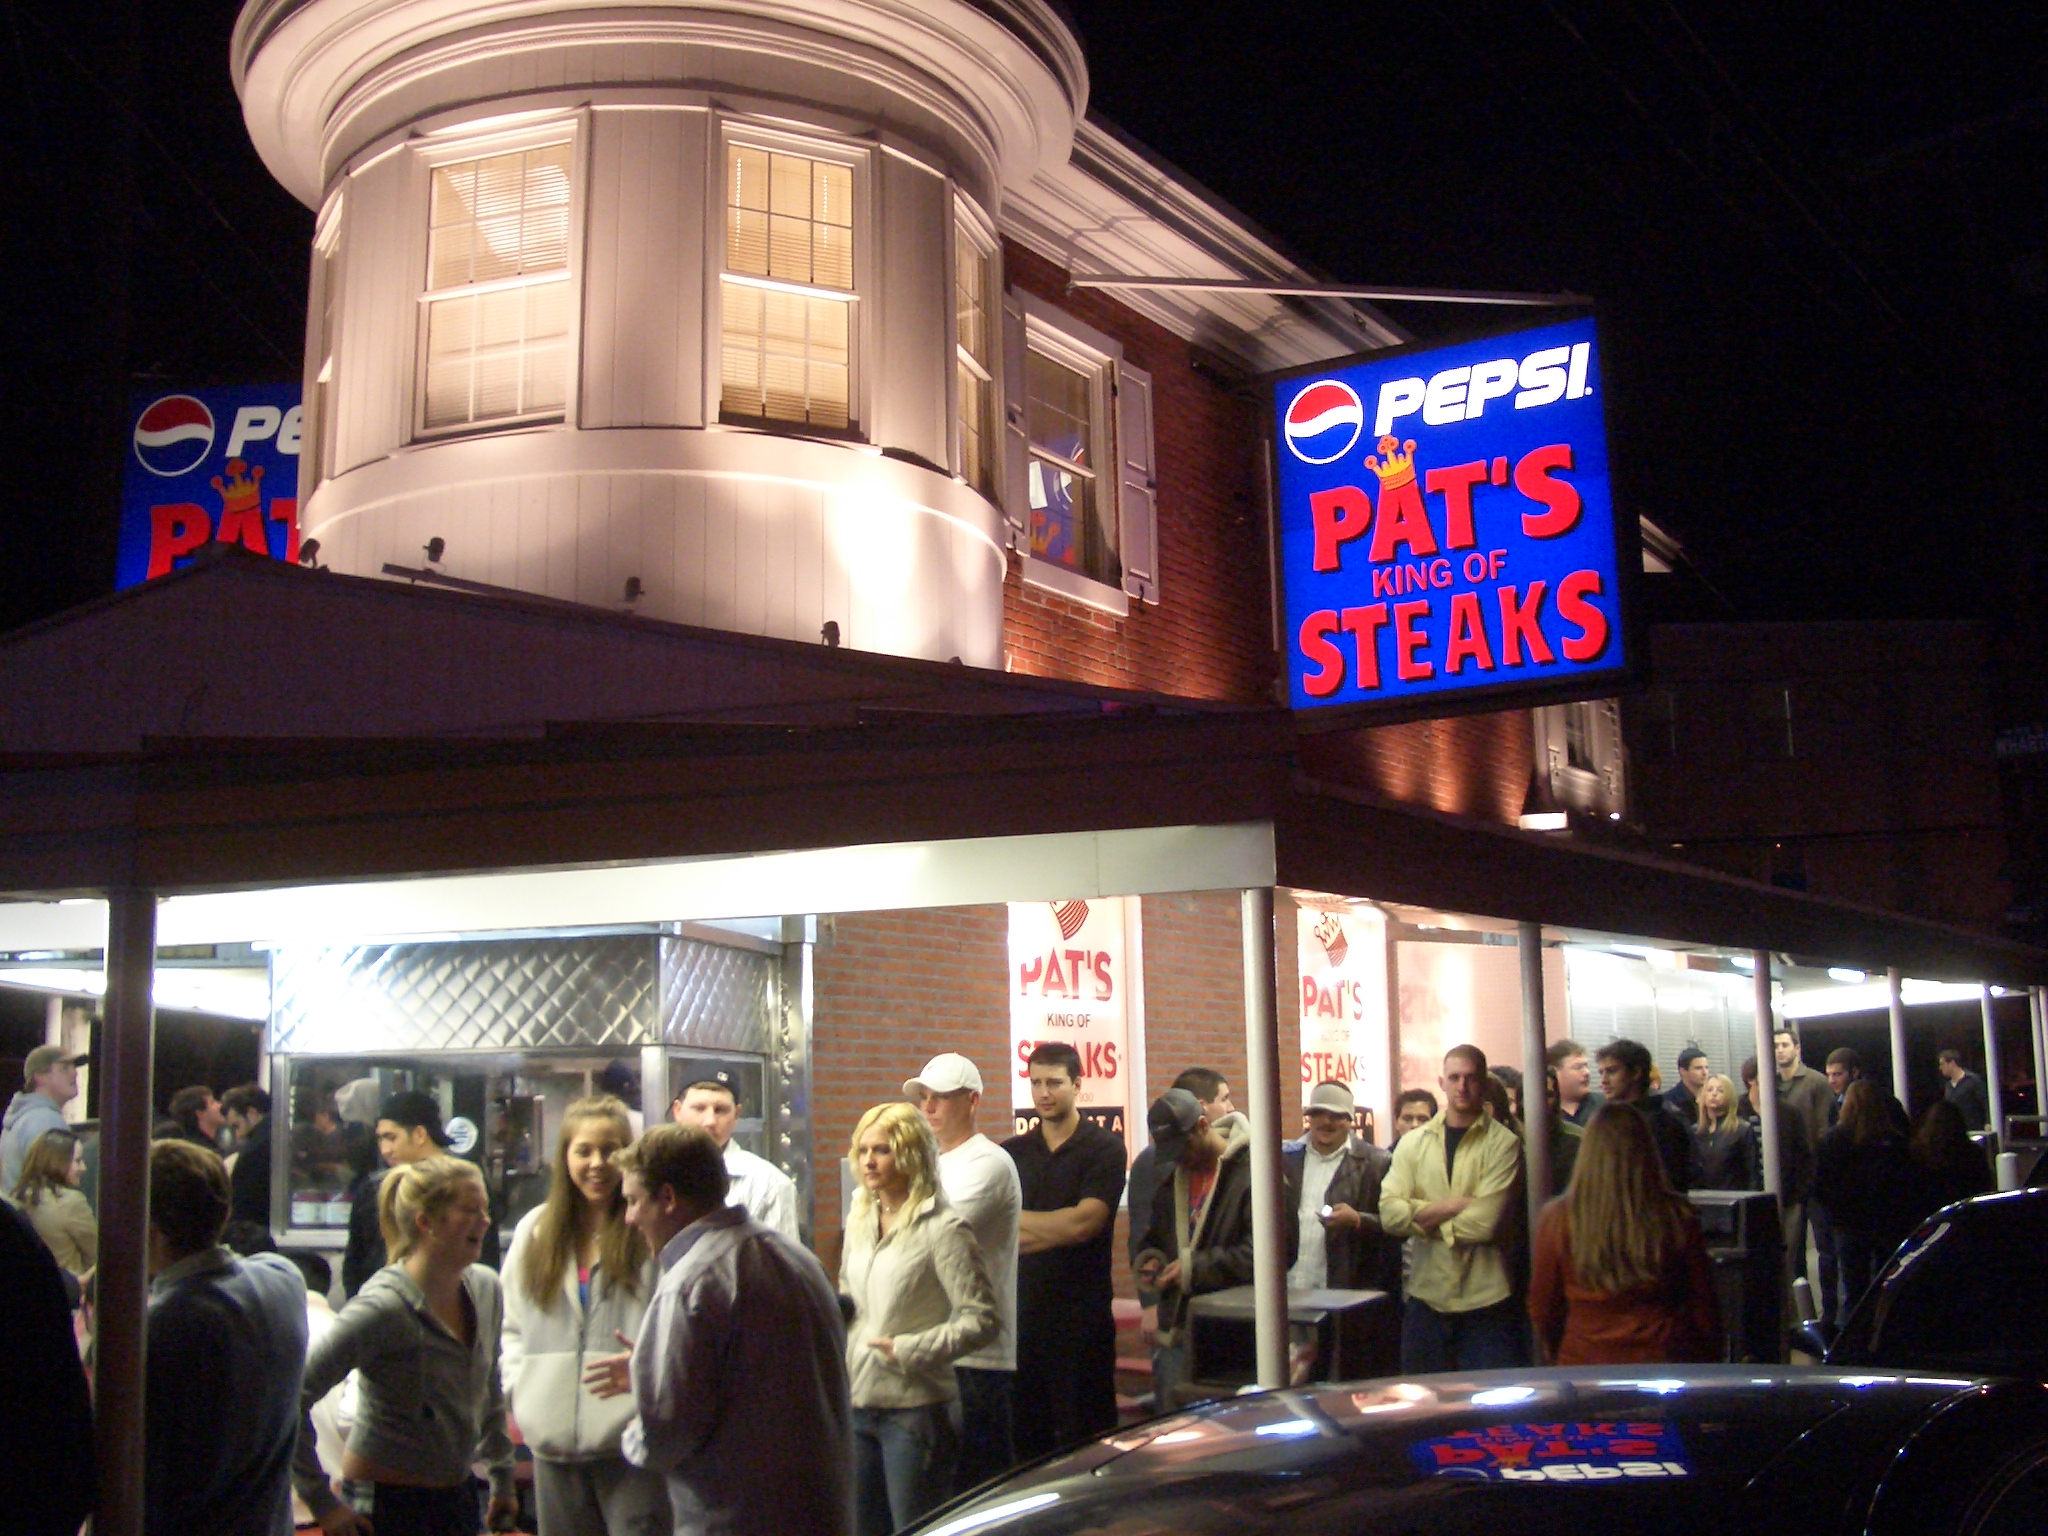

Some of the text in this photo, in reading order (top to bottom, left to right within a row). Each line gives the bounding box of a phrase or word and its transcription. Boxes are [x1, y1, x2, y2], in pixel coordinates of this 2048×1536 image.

[1374, 342, 1591, 436] PEPSI
[1310, 444, 1582, 571] PAT'S
[1372, 549, 1508, 598] KING OF
[1299, 570, 1608, 696] STEAKS
[1020, 946, 1114, 1002] PAT'S
[1302, 975, 1363, 1021] PAT'S
[1047, 1012, 1091, 1028] KING OF
[1301, 1052, 1366, 1082] STEAKS
